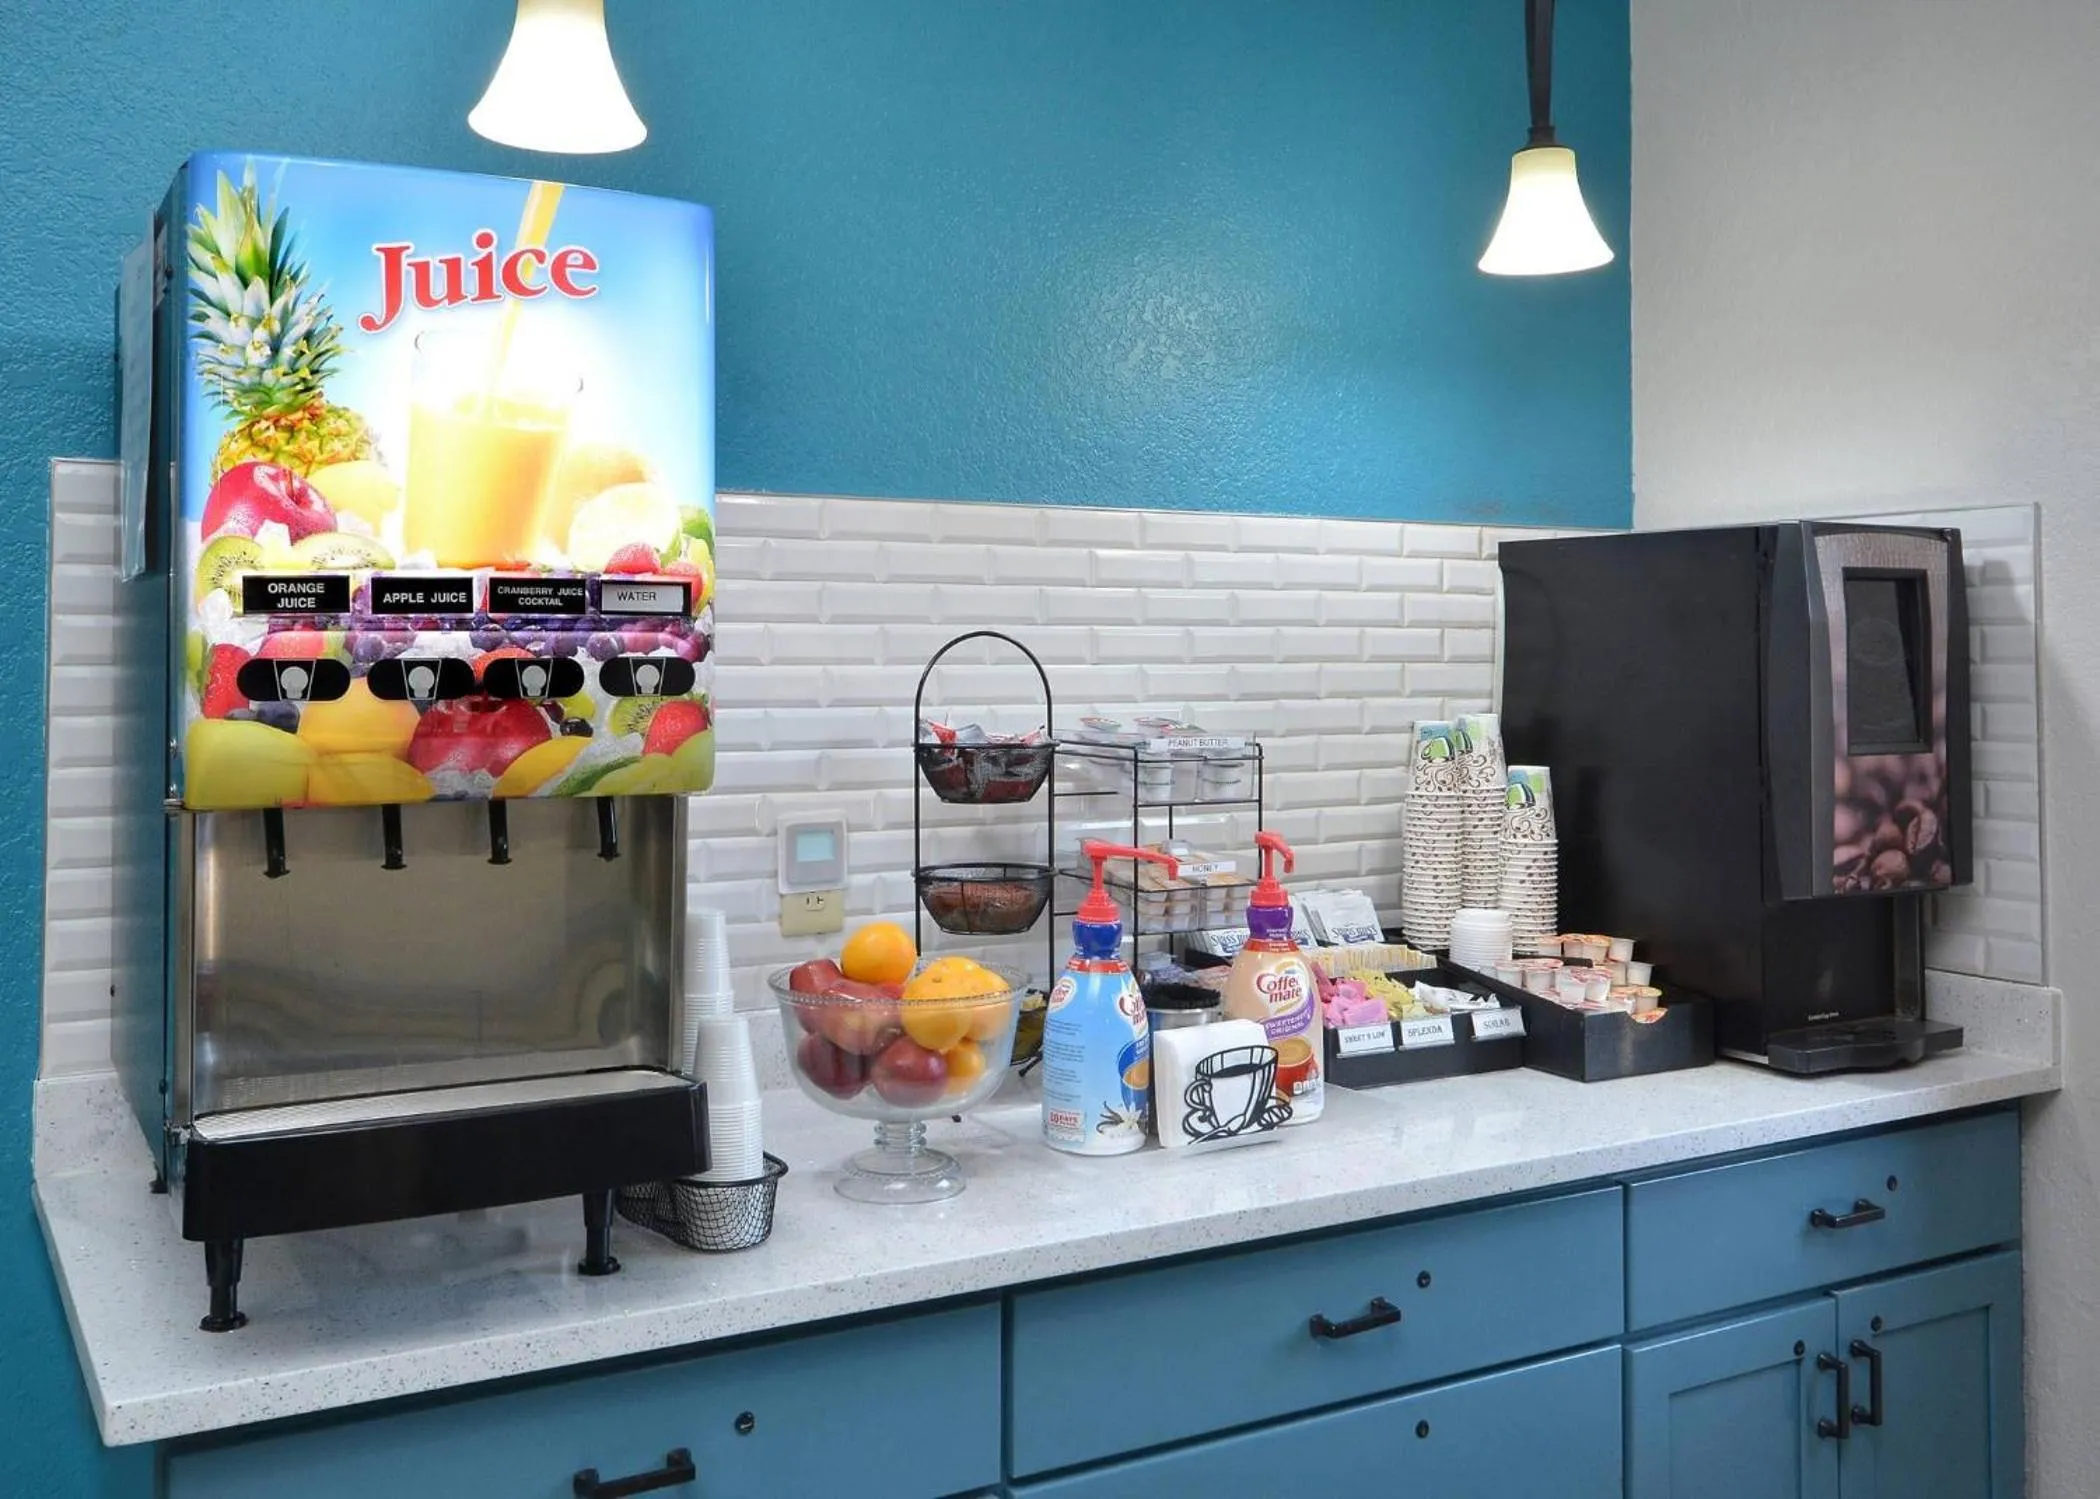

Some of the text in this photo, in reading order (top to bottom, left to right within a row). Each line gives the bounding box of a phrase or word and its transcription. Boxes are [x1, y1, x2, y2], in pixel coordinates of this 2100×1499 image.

[358, 230, 598, 333] Juice
[267, 582, 325, 594] ORANGE
[497, 585, 584, 597] CRANBERRY JUICE
[383, 592, 467, 604] APPLE JUICE
[518, 597, 564, 607] COCKTAIL
[616, 591, 657, 602] WATER
[276, 597, 317, 609] JUICE
[1168, 738, 1229, 748] PEANUT BUTTER
